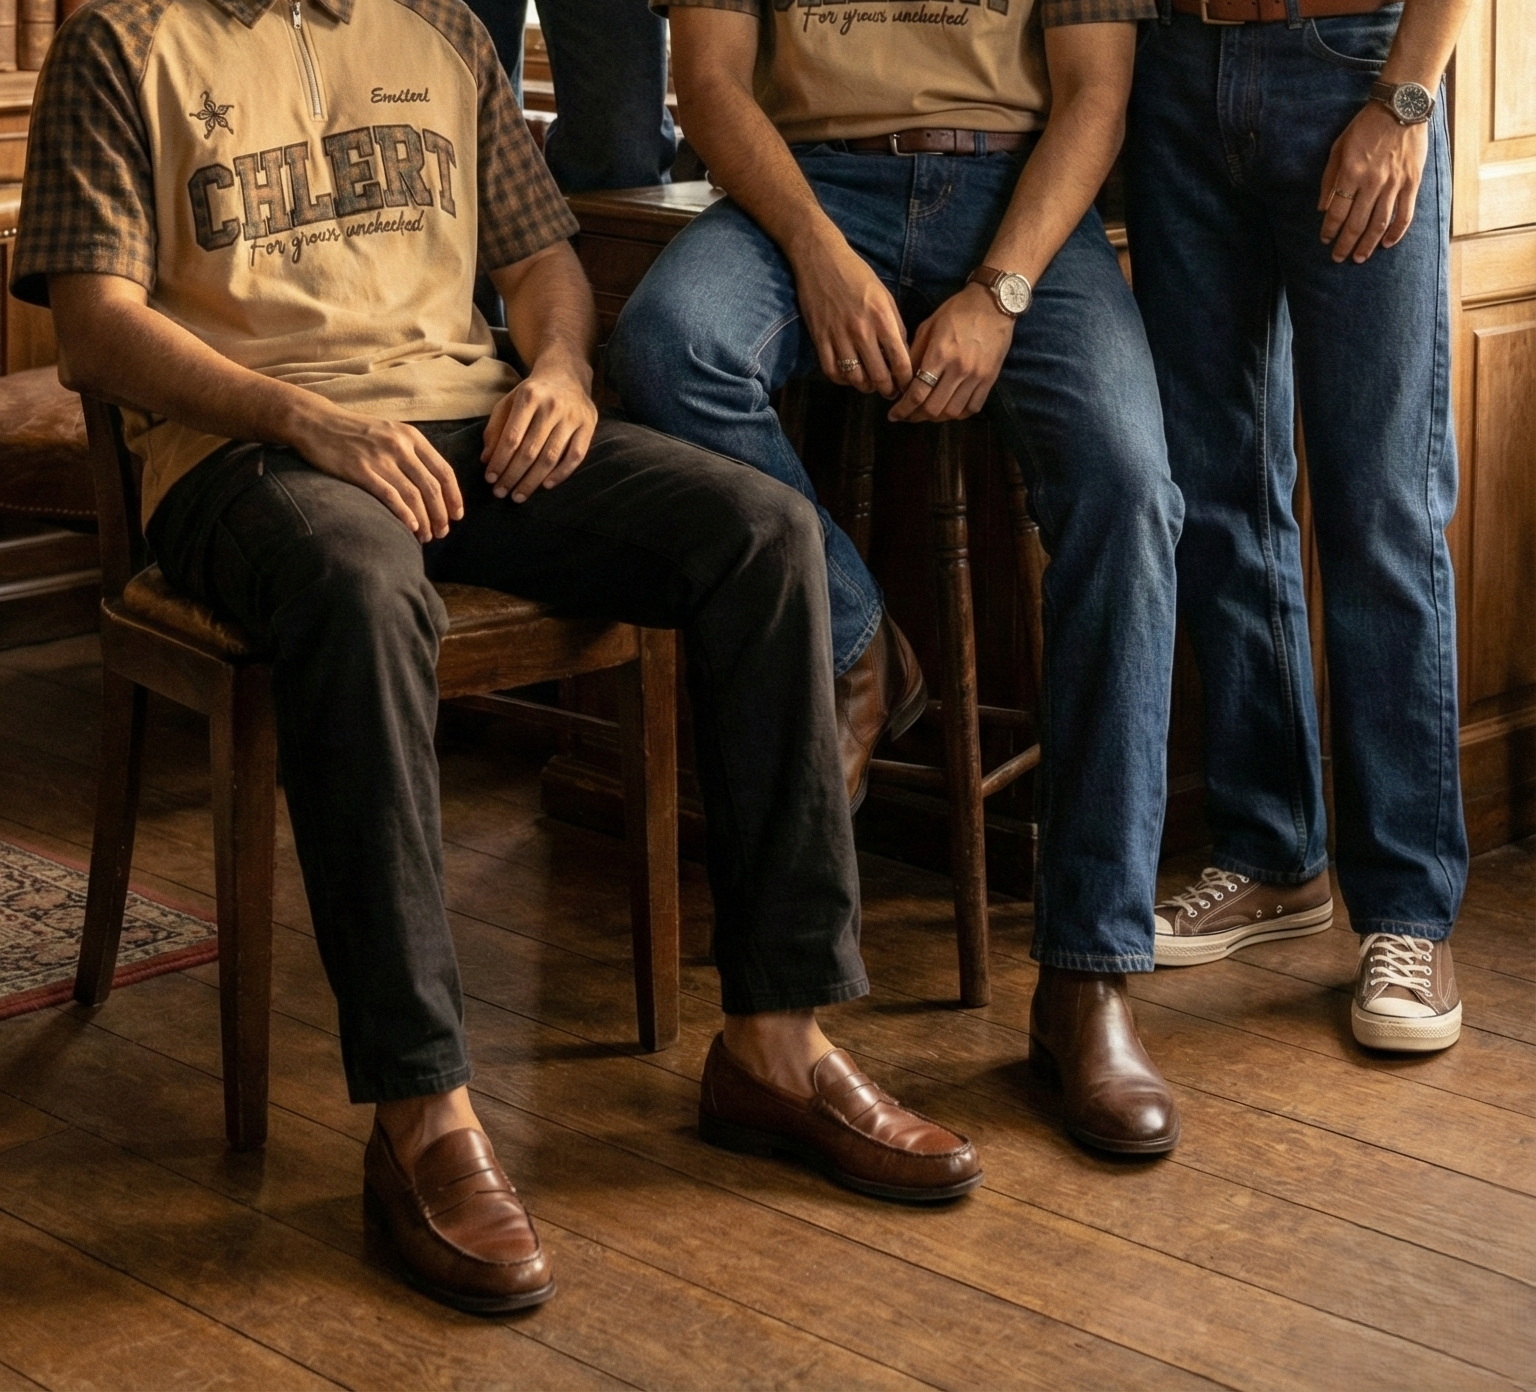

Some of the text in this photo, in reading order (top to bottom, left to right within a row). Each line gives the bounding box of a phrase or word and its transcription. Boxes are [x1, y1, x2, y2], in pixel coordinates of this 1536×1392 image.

[803, 6, 838, 33] For
[187, 124, 457, 252] CHLERT
[250, 237, 286, 267] For
